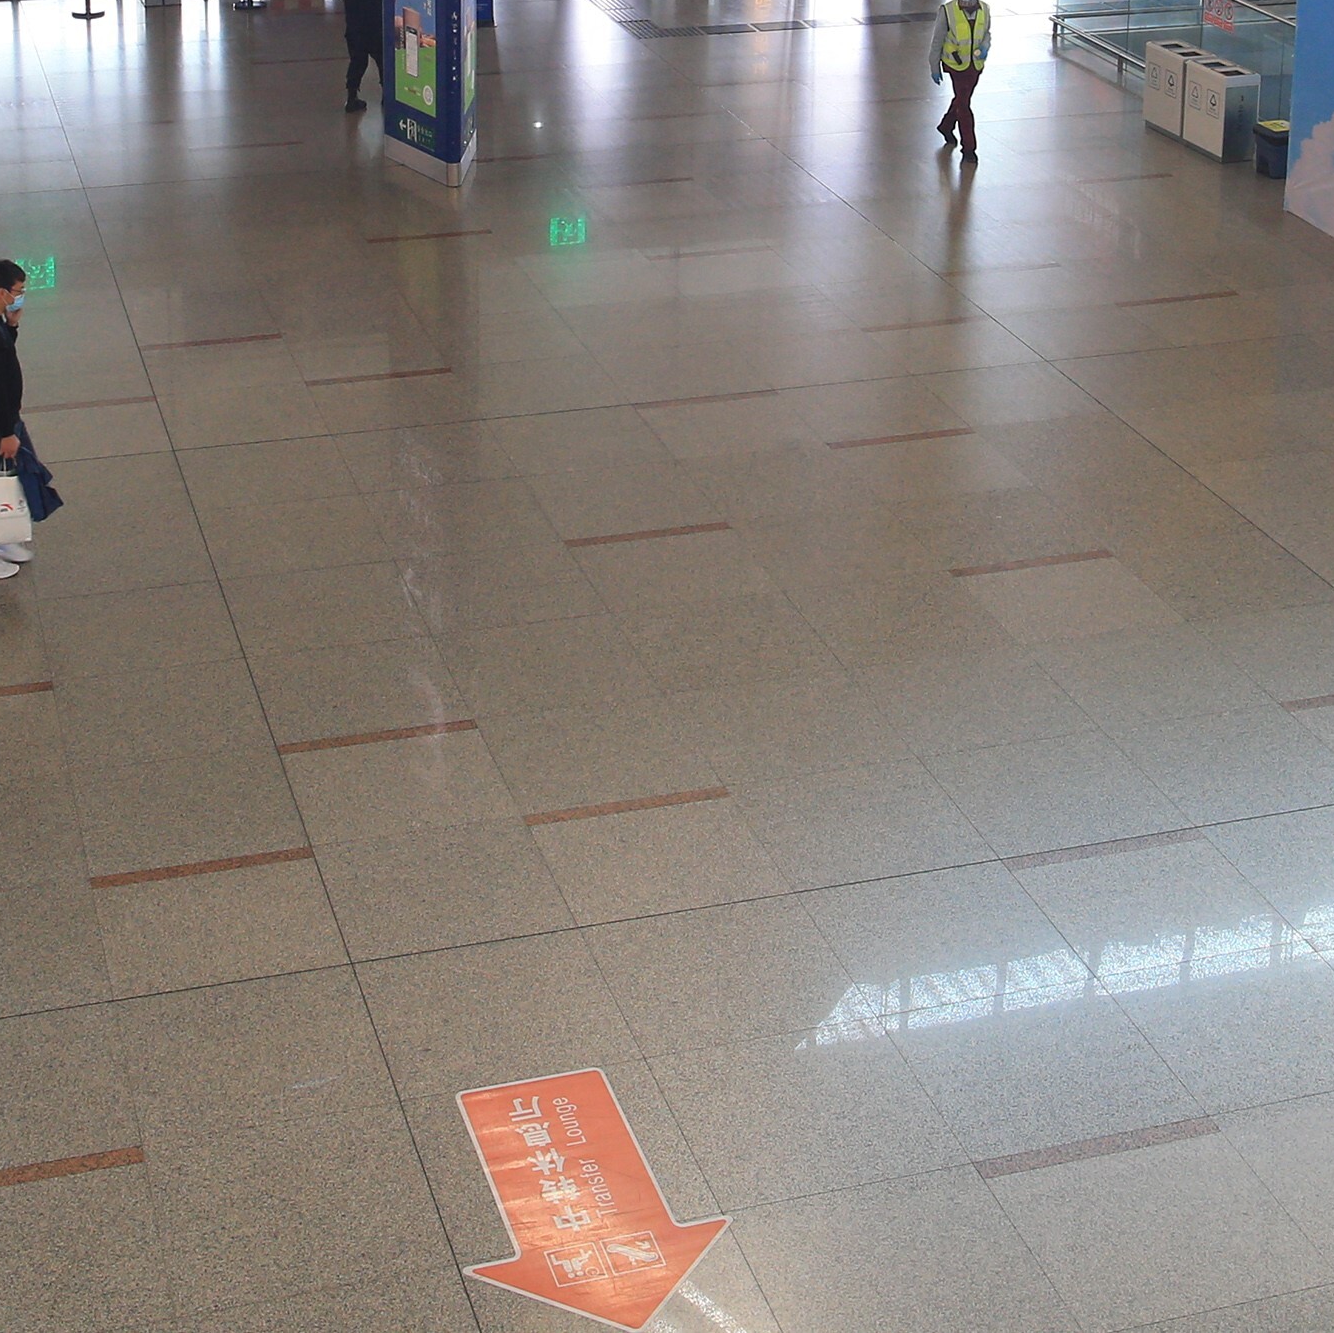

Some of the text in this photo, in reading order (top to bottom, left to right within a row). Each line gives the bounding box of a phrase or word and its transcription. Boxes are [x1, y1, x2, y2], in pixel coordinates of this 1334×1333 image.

[509, 1096, 592, 1232] 中转休息厅
[552, 1096, 617, 1218] Transfer Lounge
